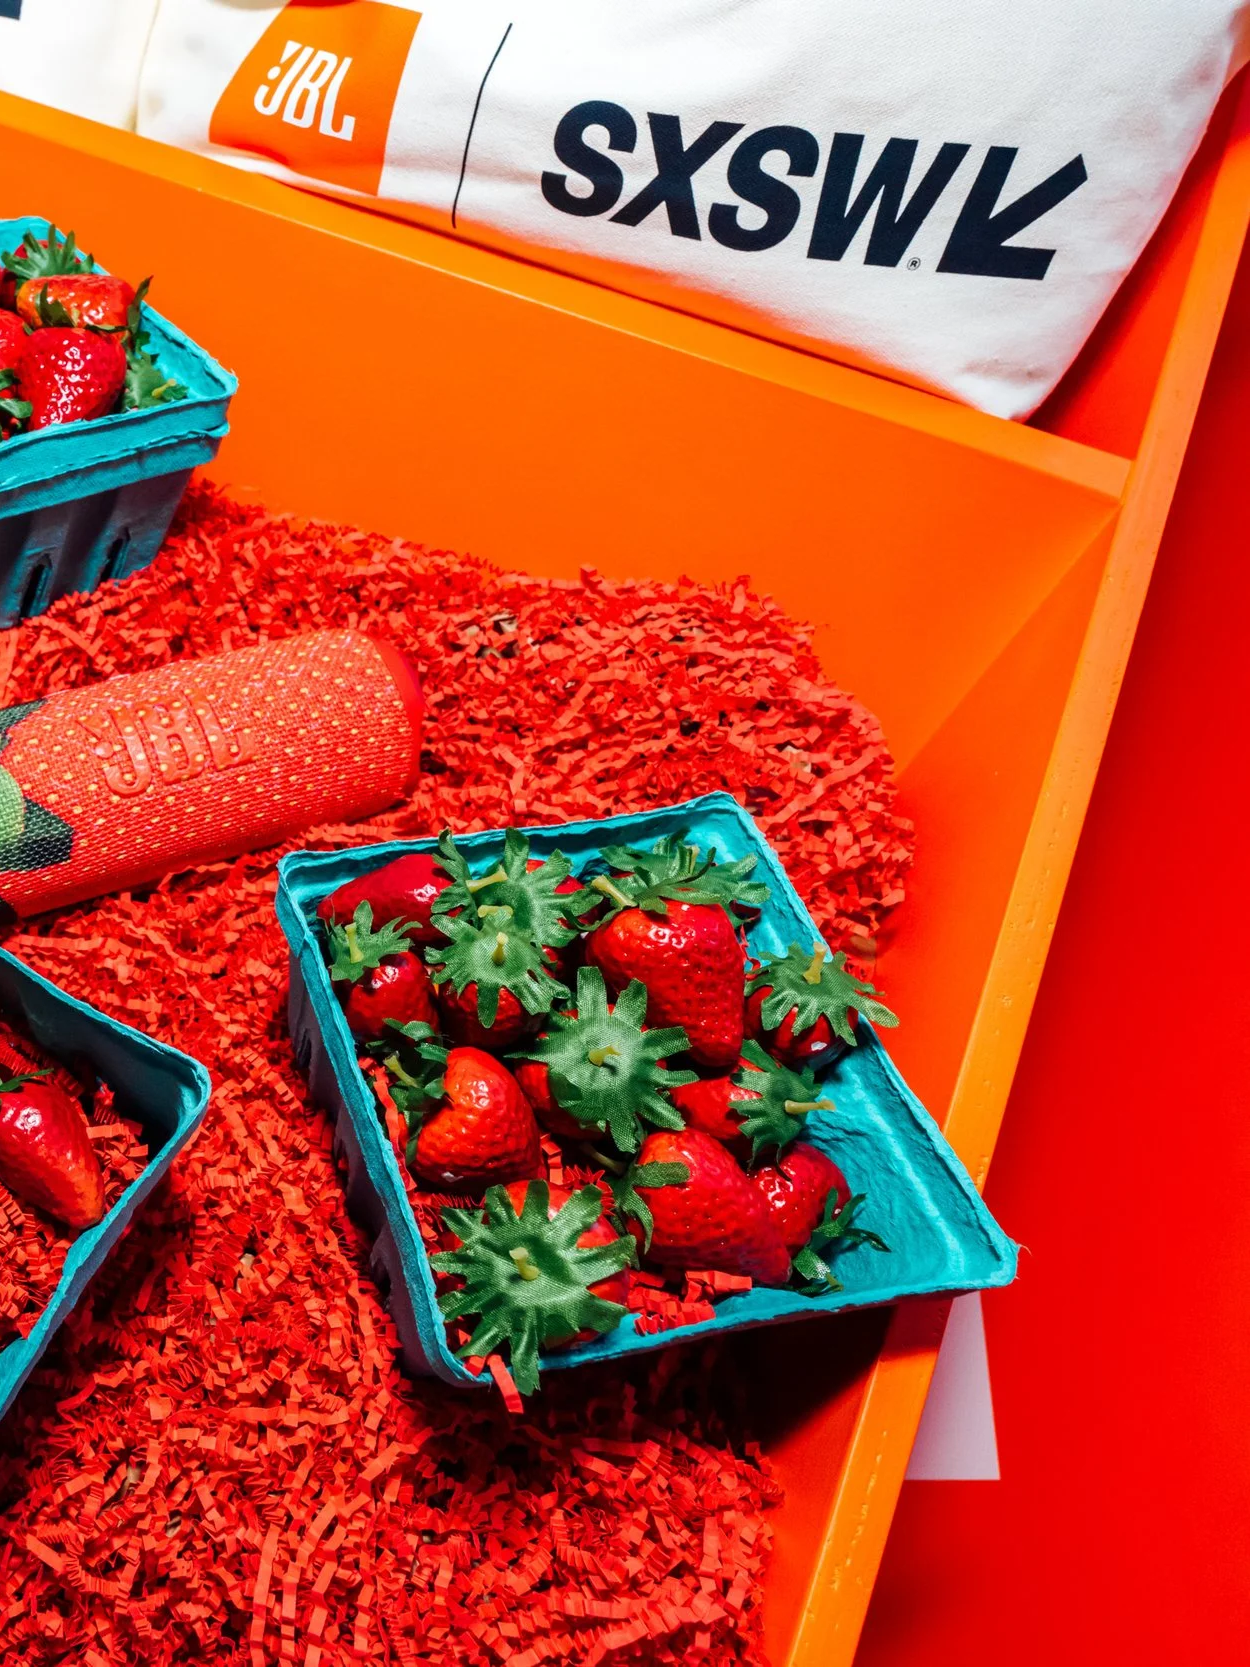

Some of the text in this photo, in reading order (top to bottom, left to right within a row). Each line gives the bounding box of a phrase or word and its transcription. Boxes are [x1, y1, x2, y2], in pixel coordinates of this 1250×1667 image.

[253, 40, 972, 268] JBL SXSW
[76, 688, 256, 798] JBL
